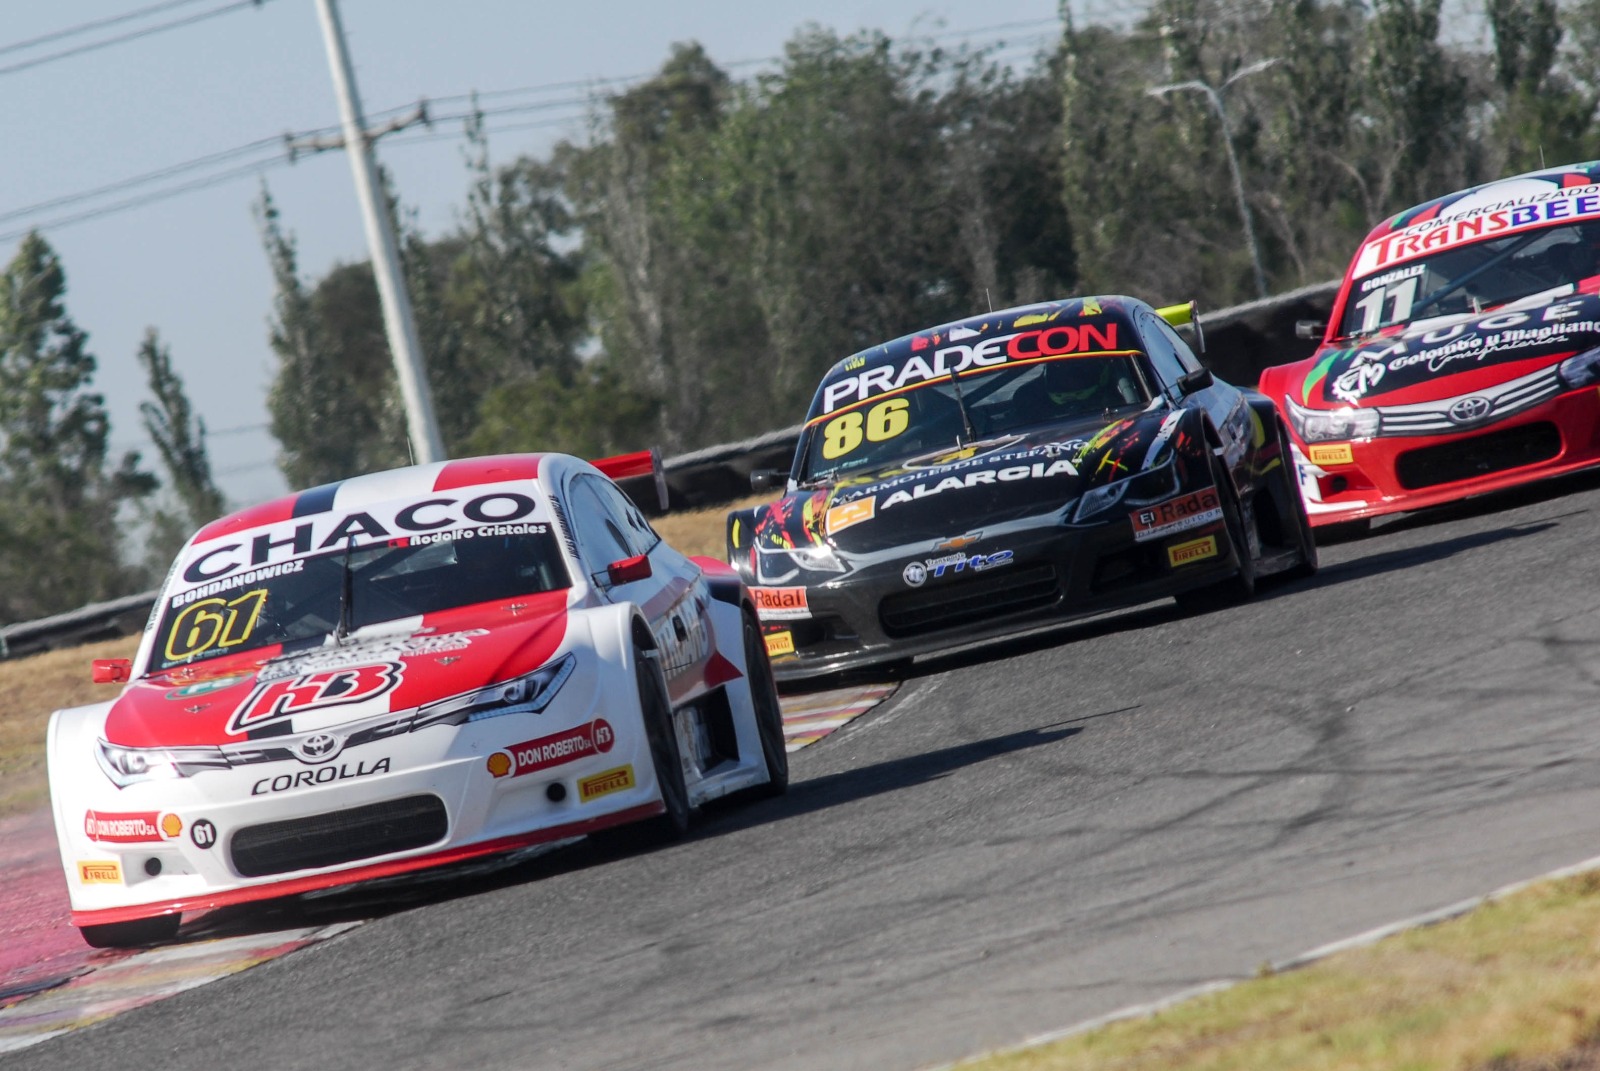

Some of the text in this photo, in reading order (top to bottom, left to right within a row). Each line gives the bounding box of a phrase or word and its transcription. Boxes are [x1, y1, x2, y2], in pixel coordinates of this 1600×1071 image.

[1361, 264, 1426, 293] GONZALEZ
[1355, 277, 1418, 334] 11
[823, 323, 1117, 414] PRADECON
[1388, 335, 1483, 372] Colombo
[822, 397, 910, 460] 86
[1313, 448, 1348, 460] PIRELLI
[880, 459, 1079, 510] ALARCIA
[1161, 493, 1217, 523] Rada
[183, 493, 536, 583] CHACO
[410, 524, 547, 547] Rodolfo Cristales
[1172, 541, 1212, 563] PIRELLI
[172, 560, 305, 609] BOHDANOWICZ
[754, 590, 802, 607] Radal
[165, 589, 268, 661] 61
[517, 747, 541, 767] DON
[543, 735, 584, 761] ROBERTO
[251, 757, 391, 796] COROLLA
[583, 770, 629, 798] PIRELLI
[109, 819, 146, 837] ROBERTO
[192, 823, 214, 846] 61
[82, 865, 119, 880] PIRELLI
